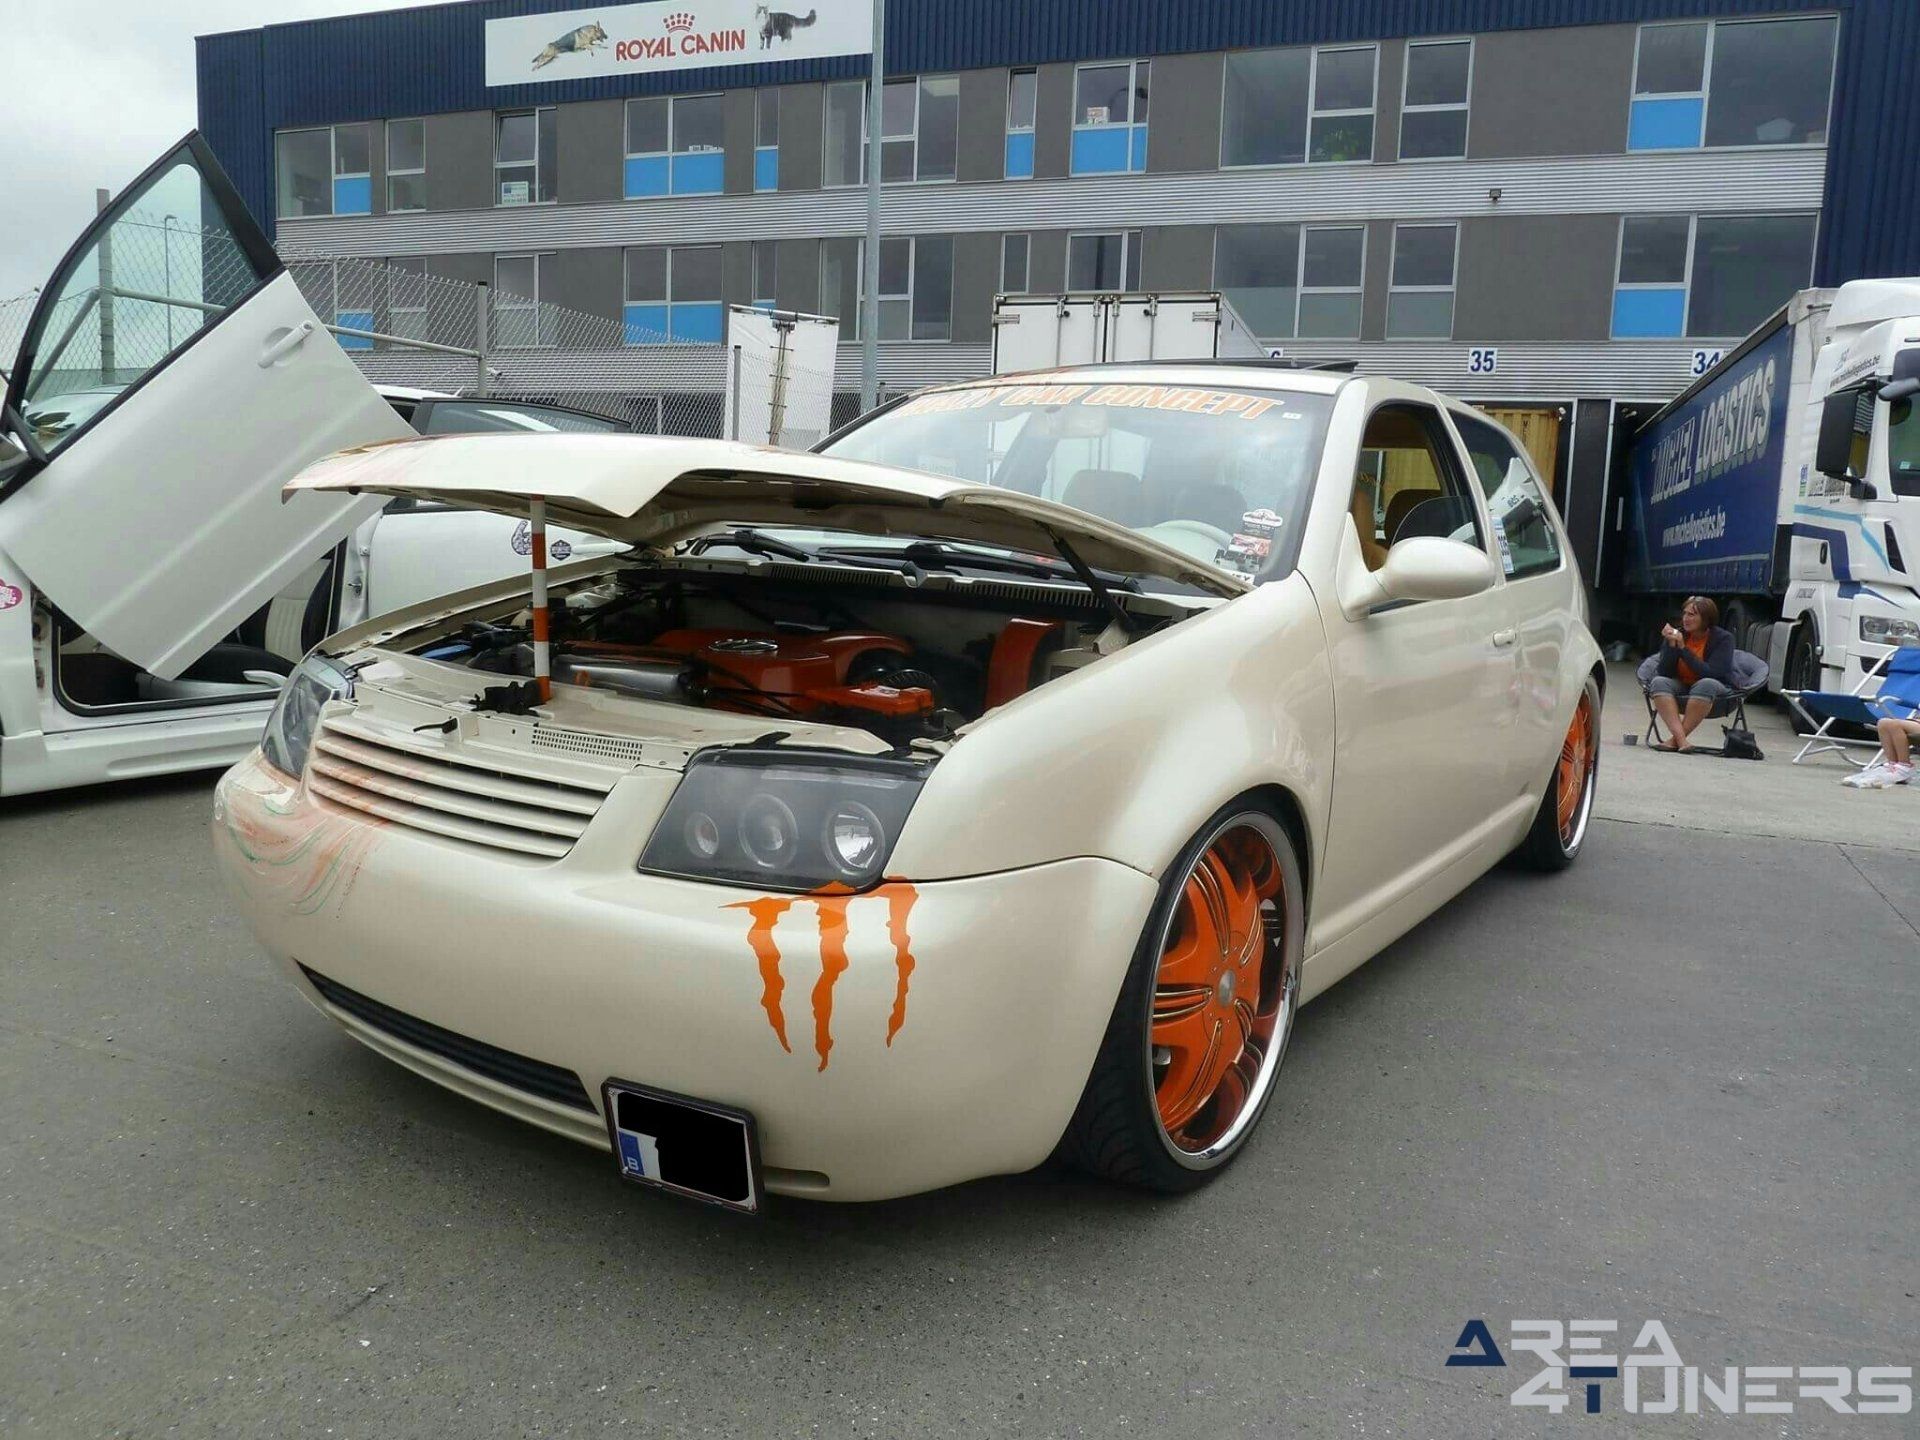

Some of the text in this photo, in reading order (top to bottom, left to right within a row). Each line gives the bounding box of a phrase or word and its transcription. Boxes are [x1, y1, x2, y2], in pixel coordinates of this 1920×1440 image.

[615, 29, 746, 61] ROYAL CANIN
[1470, 350, 1495, 372] 35
[1000, 384, 1092, 407] CAR
[1081, 384, 1286, 420] CONCEPT
[1694, 357, 1776, 480] LOGISTICS
[627, 1156, 639, 1171] B
